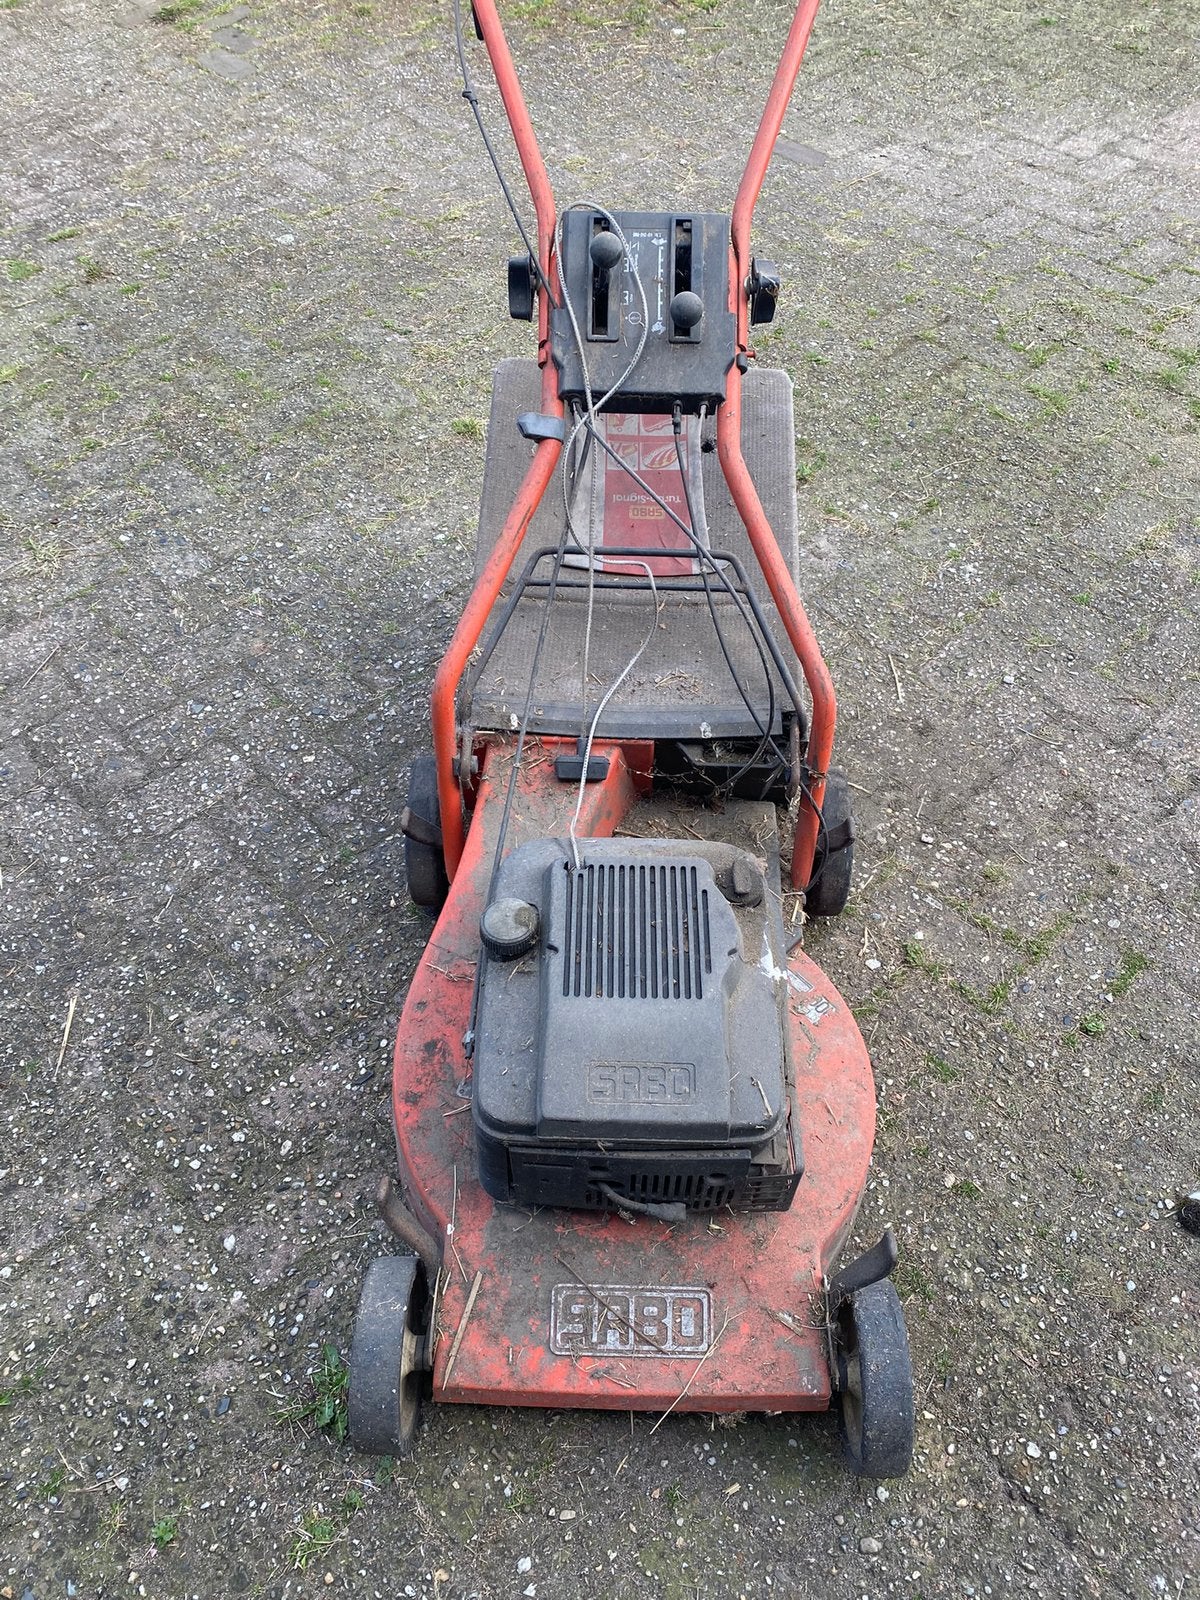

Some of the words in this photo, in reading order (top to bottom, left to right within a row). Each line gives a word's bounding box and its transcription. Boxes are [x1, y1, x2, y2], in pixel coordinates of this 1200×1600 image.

[613, 493, 681, 503] Tur-Signal
[632, 508, 663, 517] SABO
[592, 1065, 691, 1100] SABO
[559, 1292, 705, 1348] SABO
